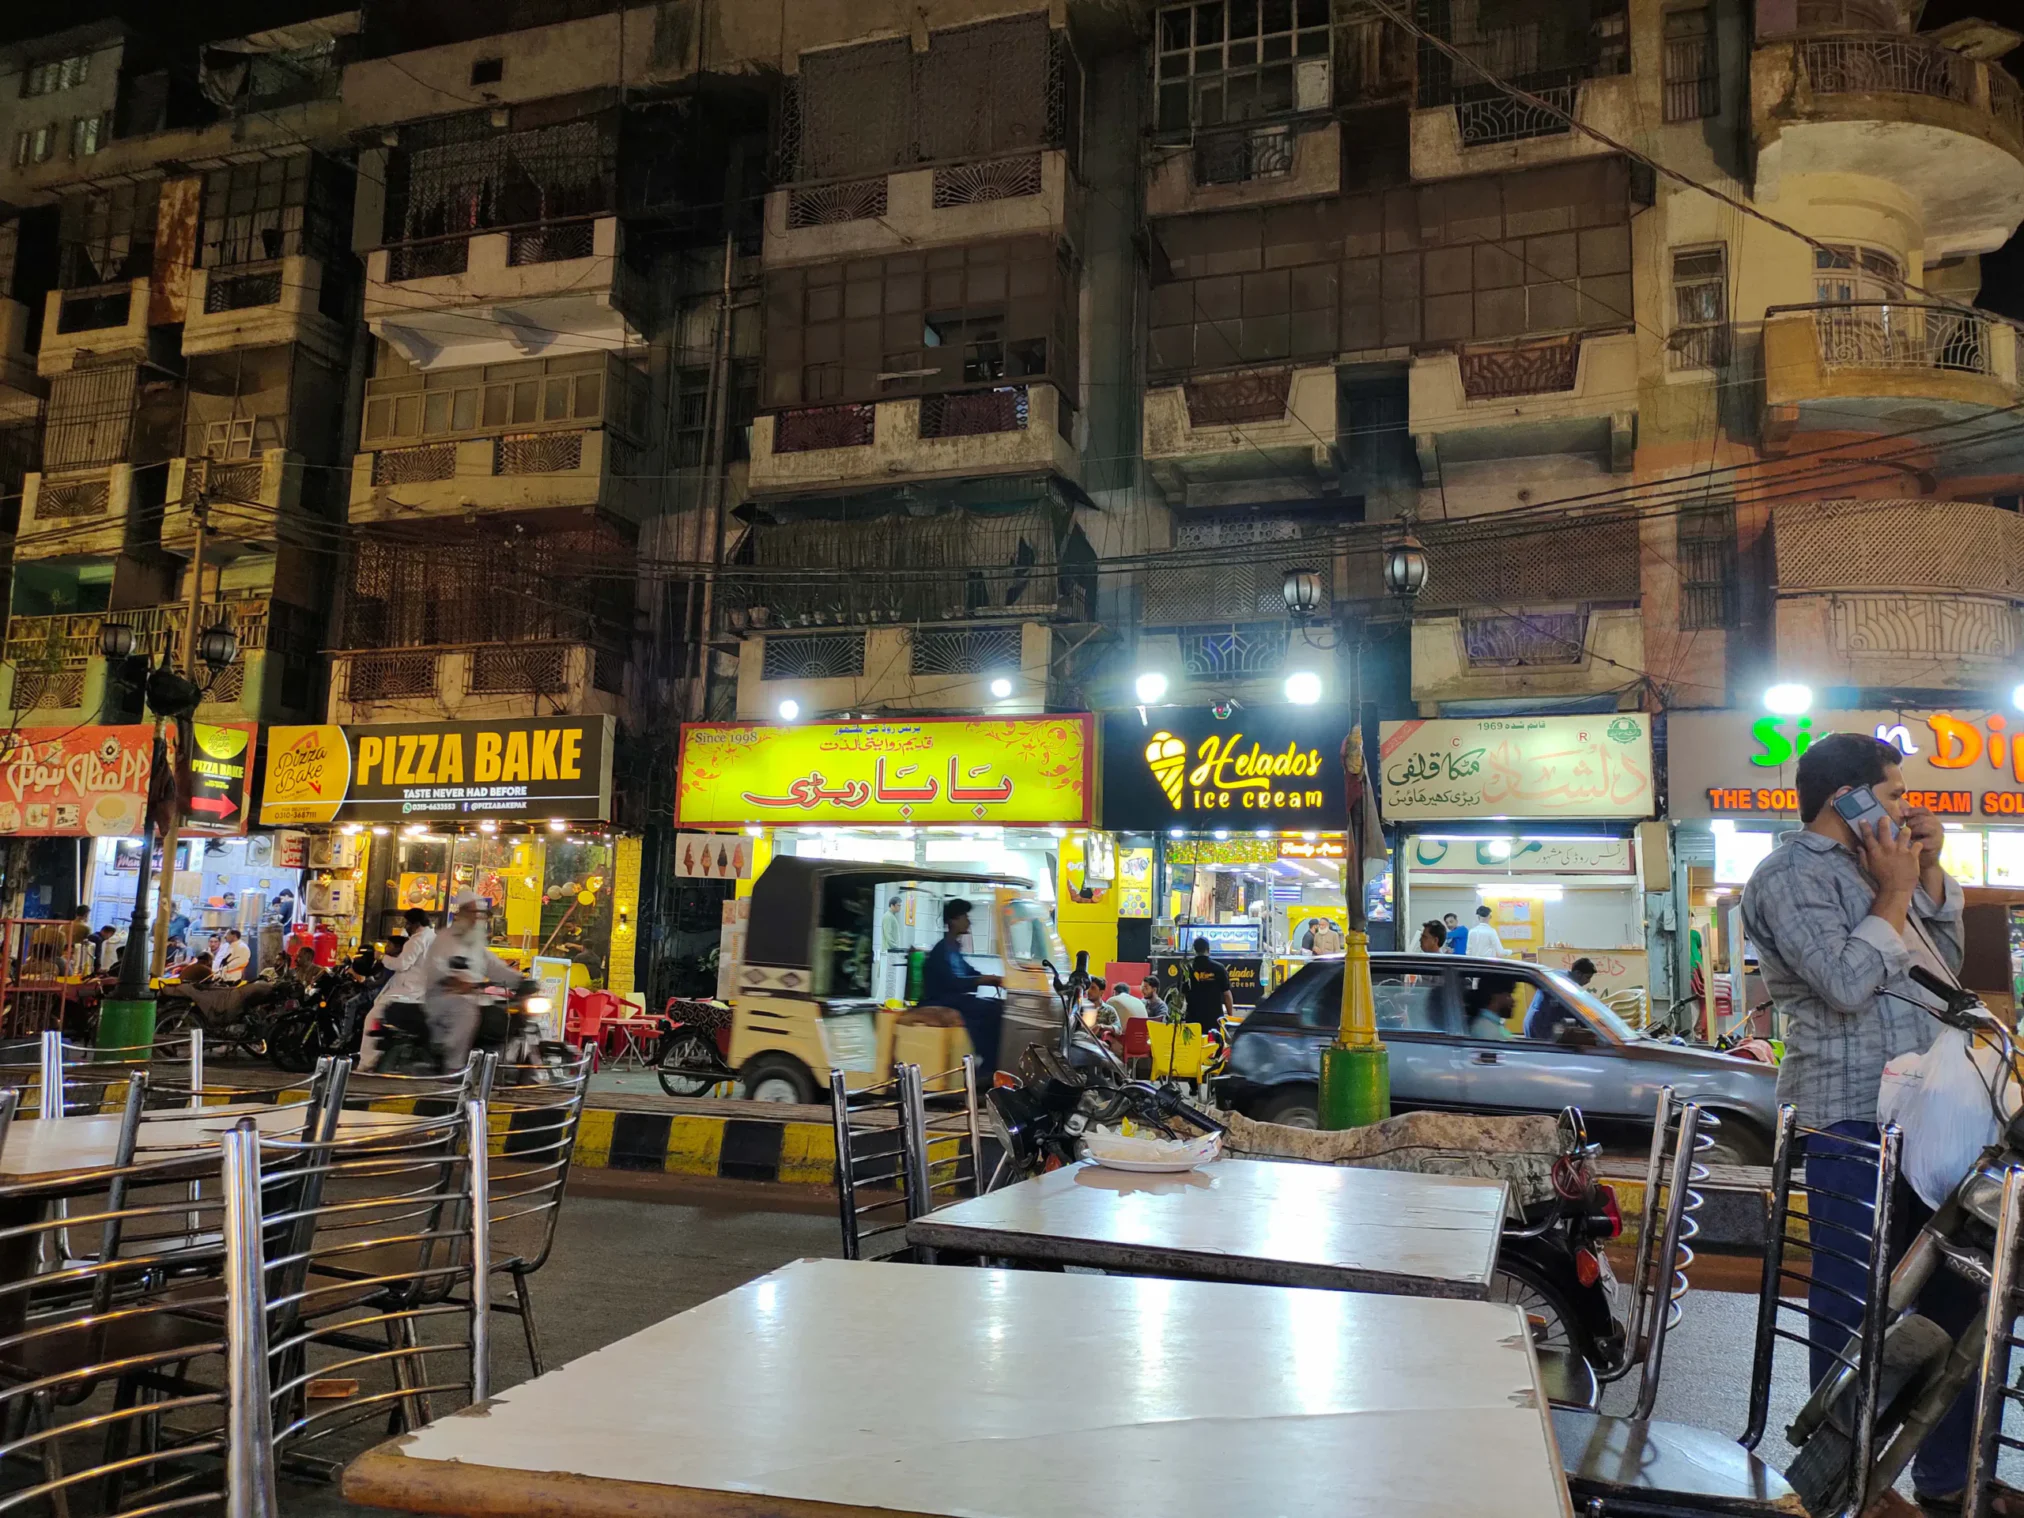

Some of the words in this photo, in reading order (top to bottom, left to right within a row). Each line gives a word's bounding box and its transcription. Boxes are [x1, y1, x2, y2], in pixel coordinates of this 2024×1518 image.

[695, 732, 726, 743] Since
[730, 731, 758, 743] 1998
[1477, 722, 1503, 731] 1969
[1751, 716, 1829, 767] Si
[274, 747, 328, 777] Pizza
[357, 733, 464, 786] PIZZA
[474, 729, 583, 782] BAKE
[1189, 733, 1323, 790] Helados
[192, 759, 218, 775] PIZZA
[220, 763, 244, 778] BAKE
[276, 762, 324, 793] Bake
[403, 789, 431, 799] TASTE
[433, 788, 464, 798] NEVER
[466, 787, 488, 797] HAD
[490, 786, 527, 796] BEFORE
[1710, 789, 1751, 808] THE
[1758, 789, 1798, 809] SOD
[1901, 791, 1971, 813] REAM
[471, 802, 527, 811] @PIZZABAKEPAK
